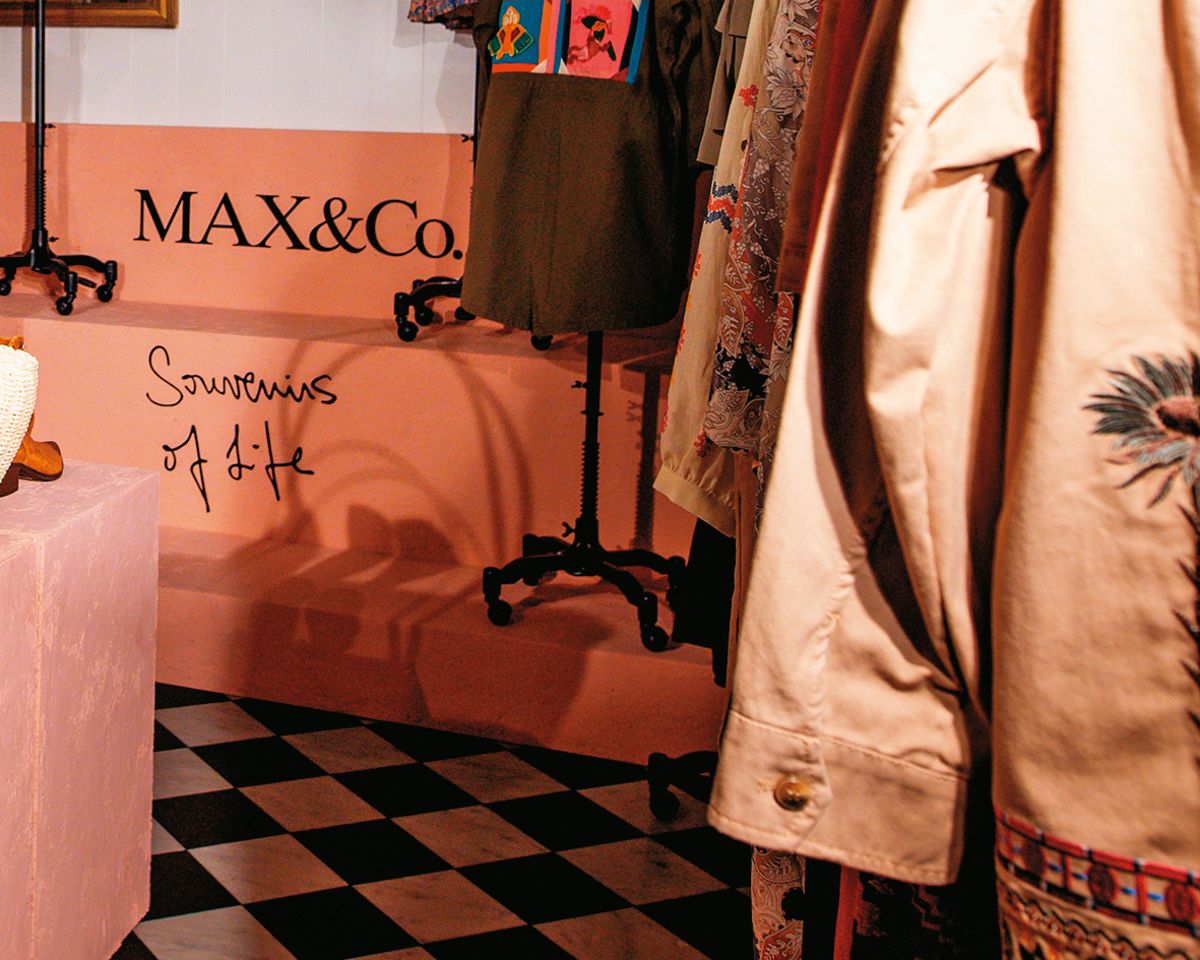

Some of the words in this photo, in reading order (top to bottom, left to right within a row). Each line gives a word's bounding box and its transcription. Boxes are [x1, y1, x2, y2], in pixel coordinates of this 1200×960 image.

[133, 189, 463, 259] MAX&Co.
[146, 345, 337, 407] Souvenirs
[162, 425, 210, 513] of
[226, 421, 314, 501] Life
